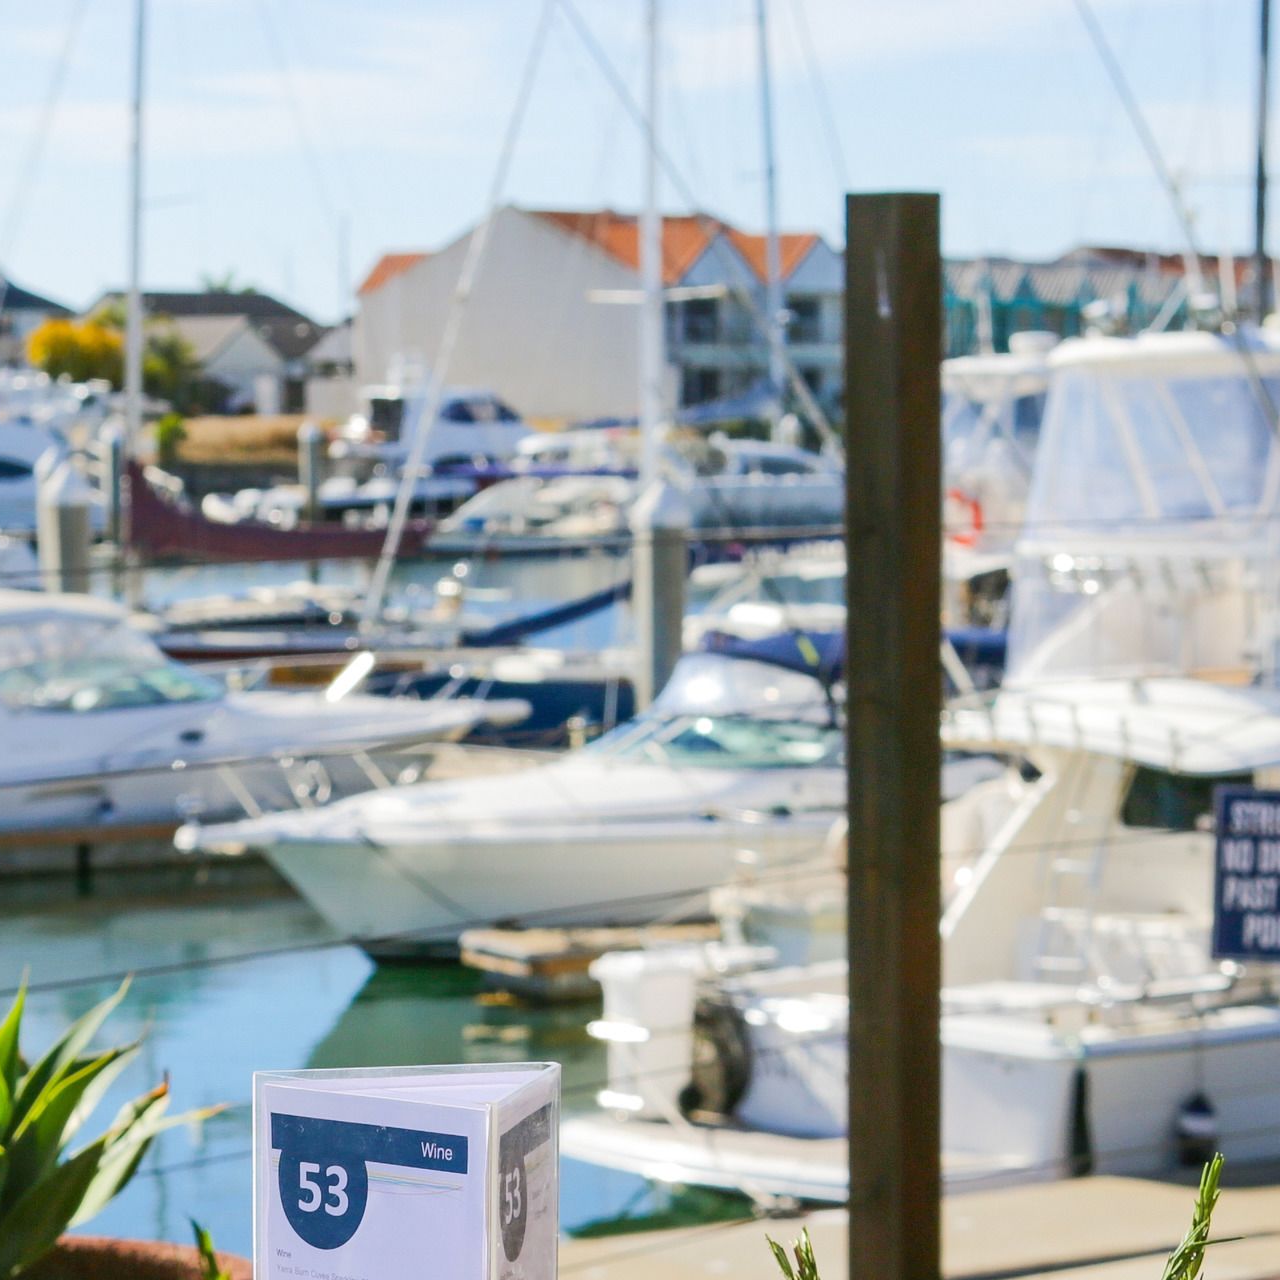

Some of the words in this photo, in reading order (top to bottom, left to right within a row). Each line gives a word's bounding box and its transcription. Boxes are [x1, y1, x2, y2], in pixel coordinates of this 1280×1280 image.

[1222, 839, 1255, 873] NO
[1223, 876, 1278, 911] PAST
[421, 1141, 453, 1161] Wine
[298, 1161, 349, 1217] 53
[505, 1167, 522, 1225] 53
